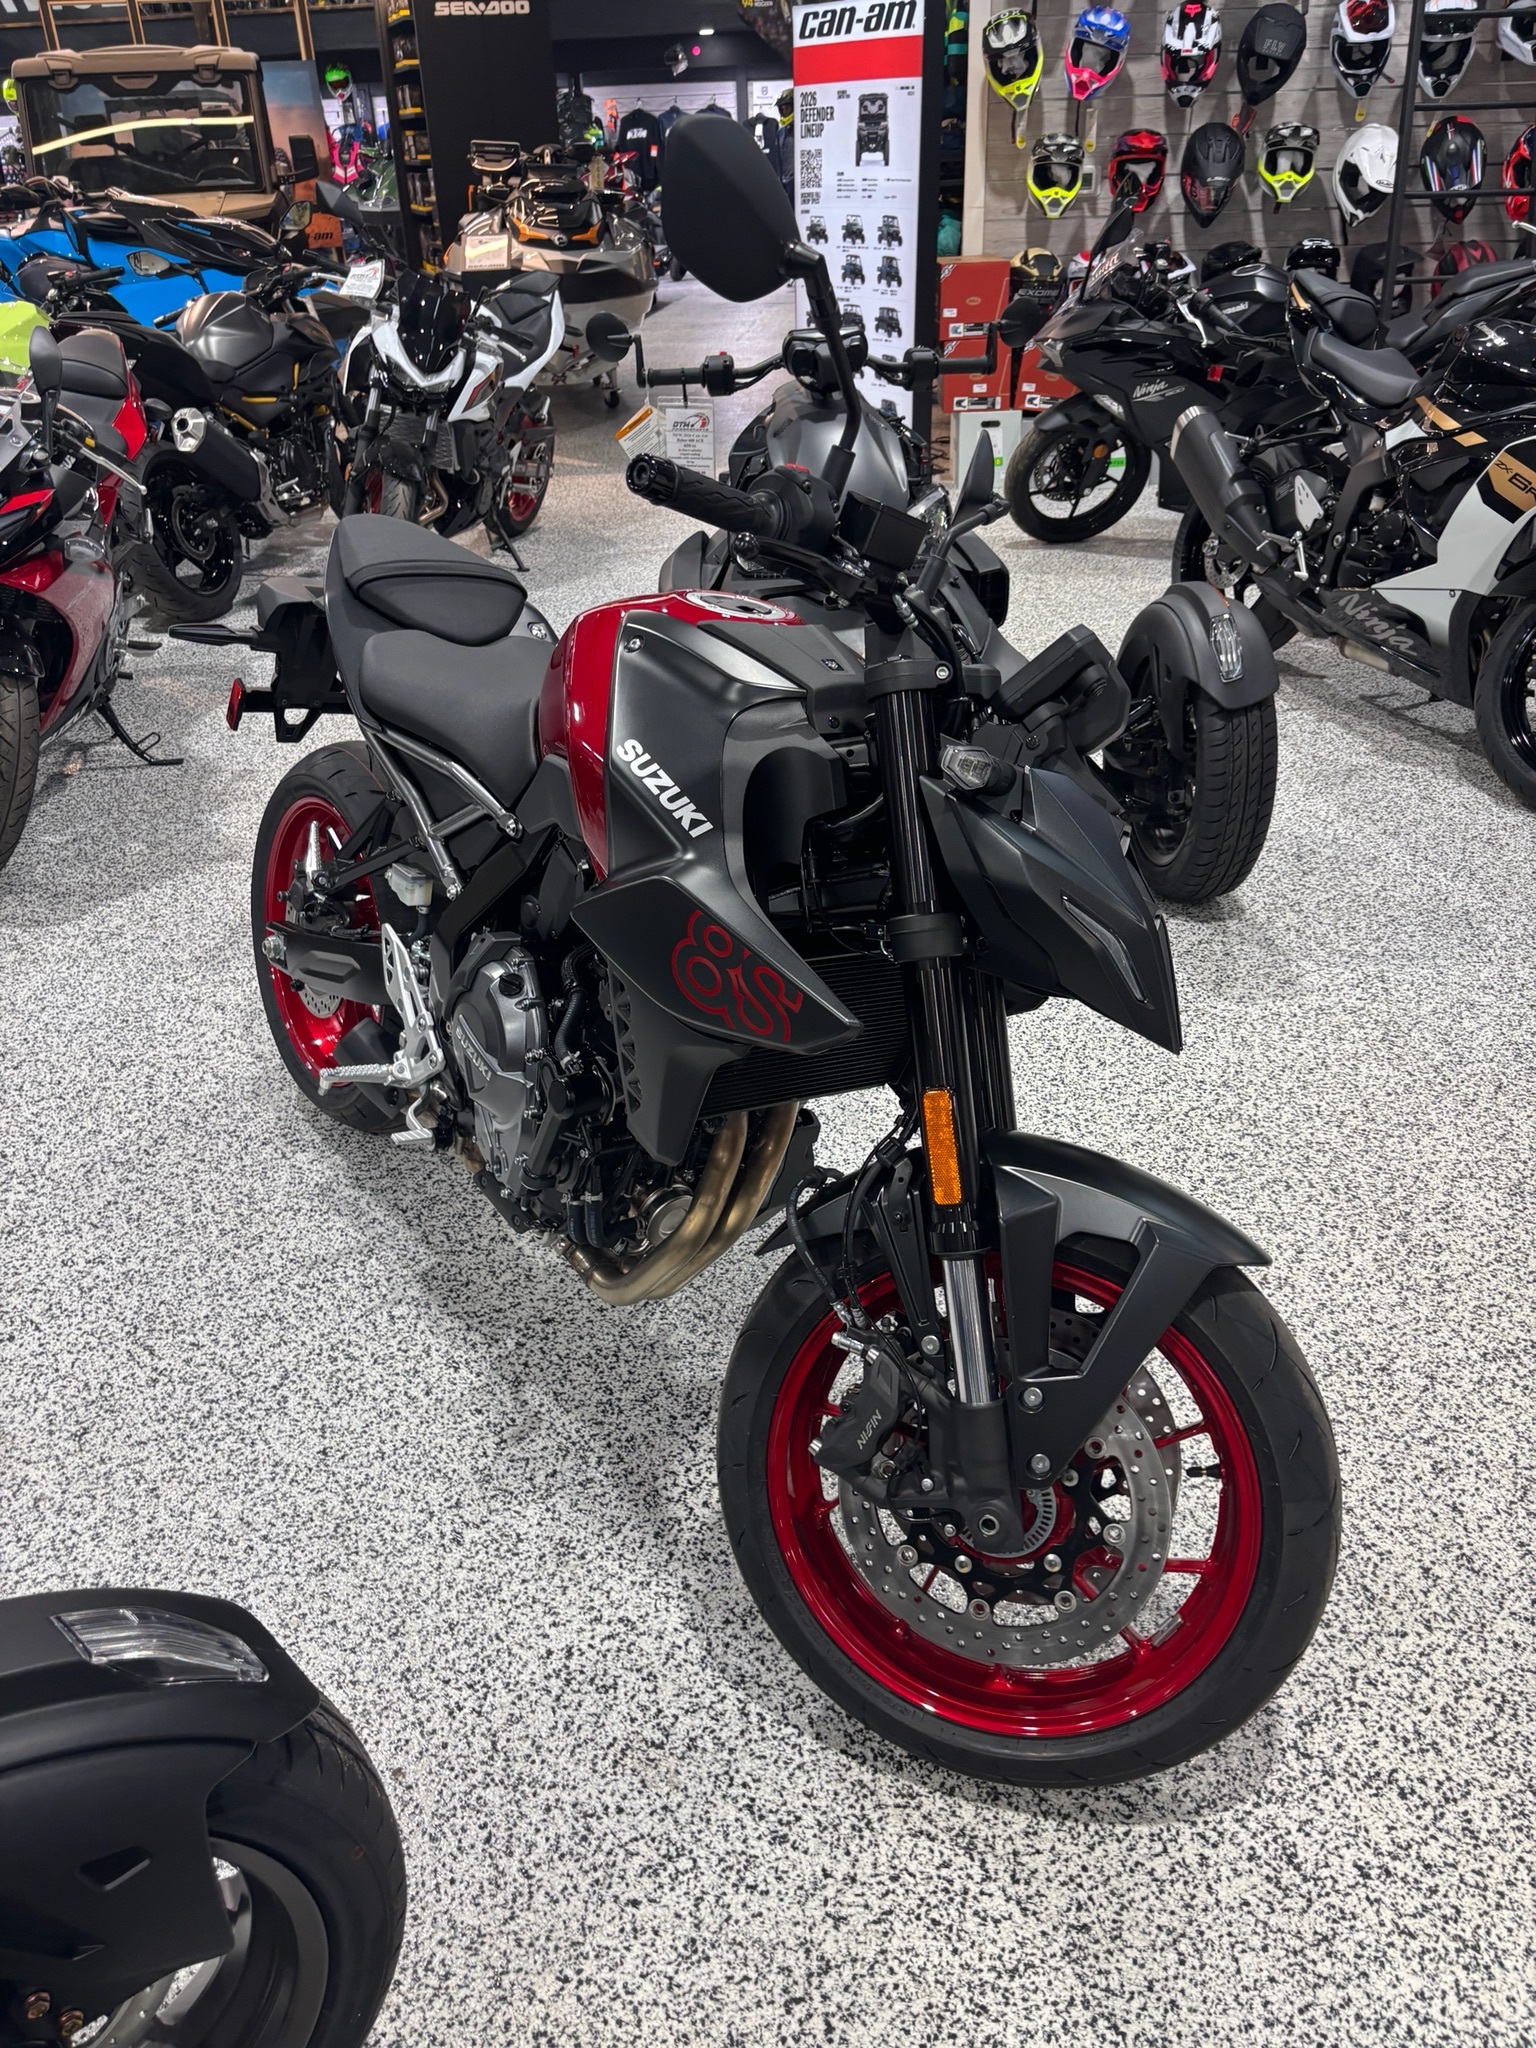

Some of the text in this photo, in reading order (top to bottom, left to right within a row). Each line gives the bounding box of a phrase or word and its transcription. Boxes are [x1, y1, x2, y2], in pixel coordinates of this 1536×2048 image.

[800, 91, 817, 107] 2026
[800, 106, 835, 123] DEFENDER
[800, 123, 825, 139] LINEUP
[1132, 379, 1169, 399] Ninja
[1338, 593, 1417, 656] Ninja
[616, 739, 714, 838] SUZUKI
[456, 1026, 492, 1081] SUZUKI
